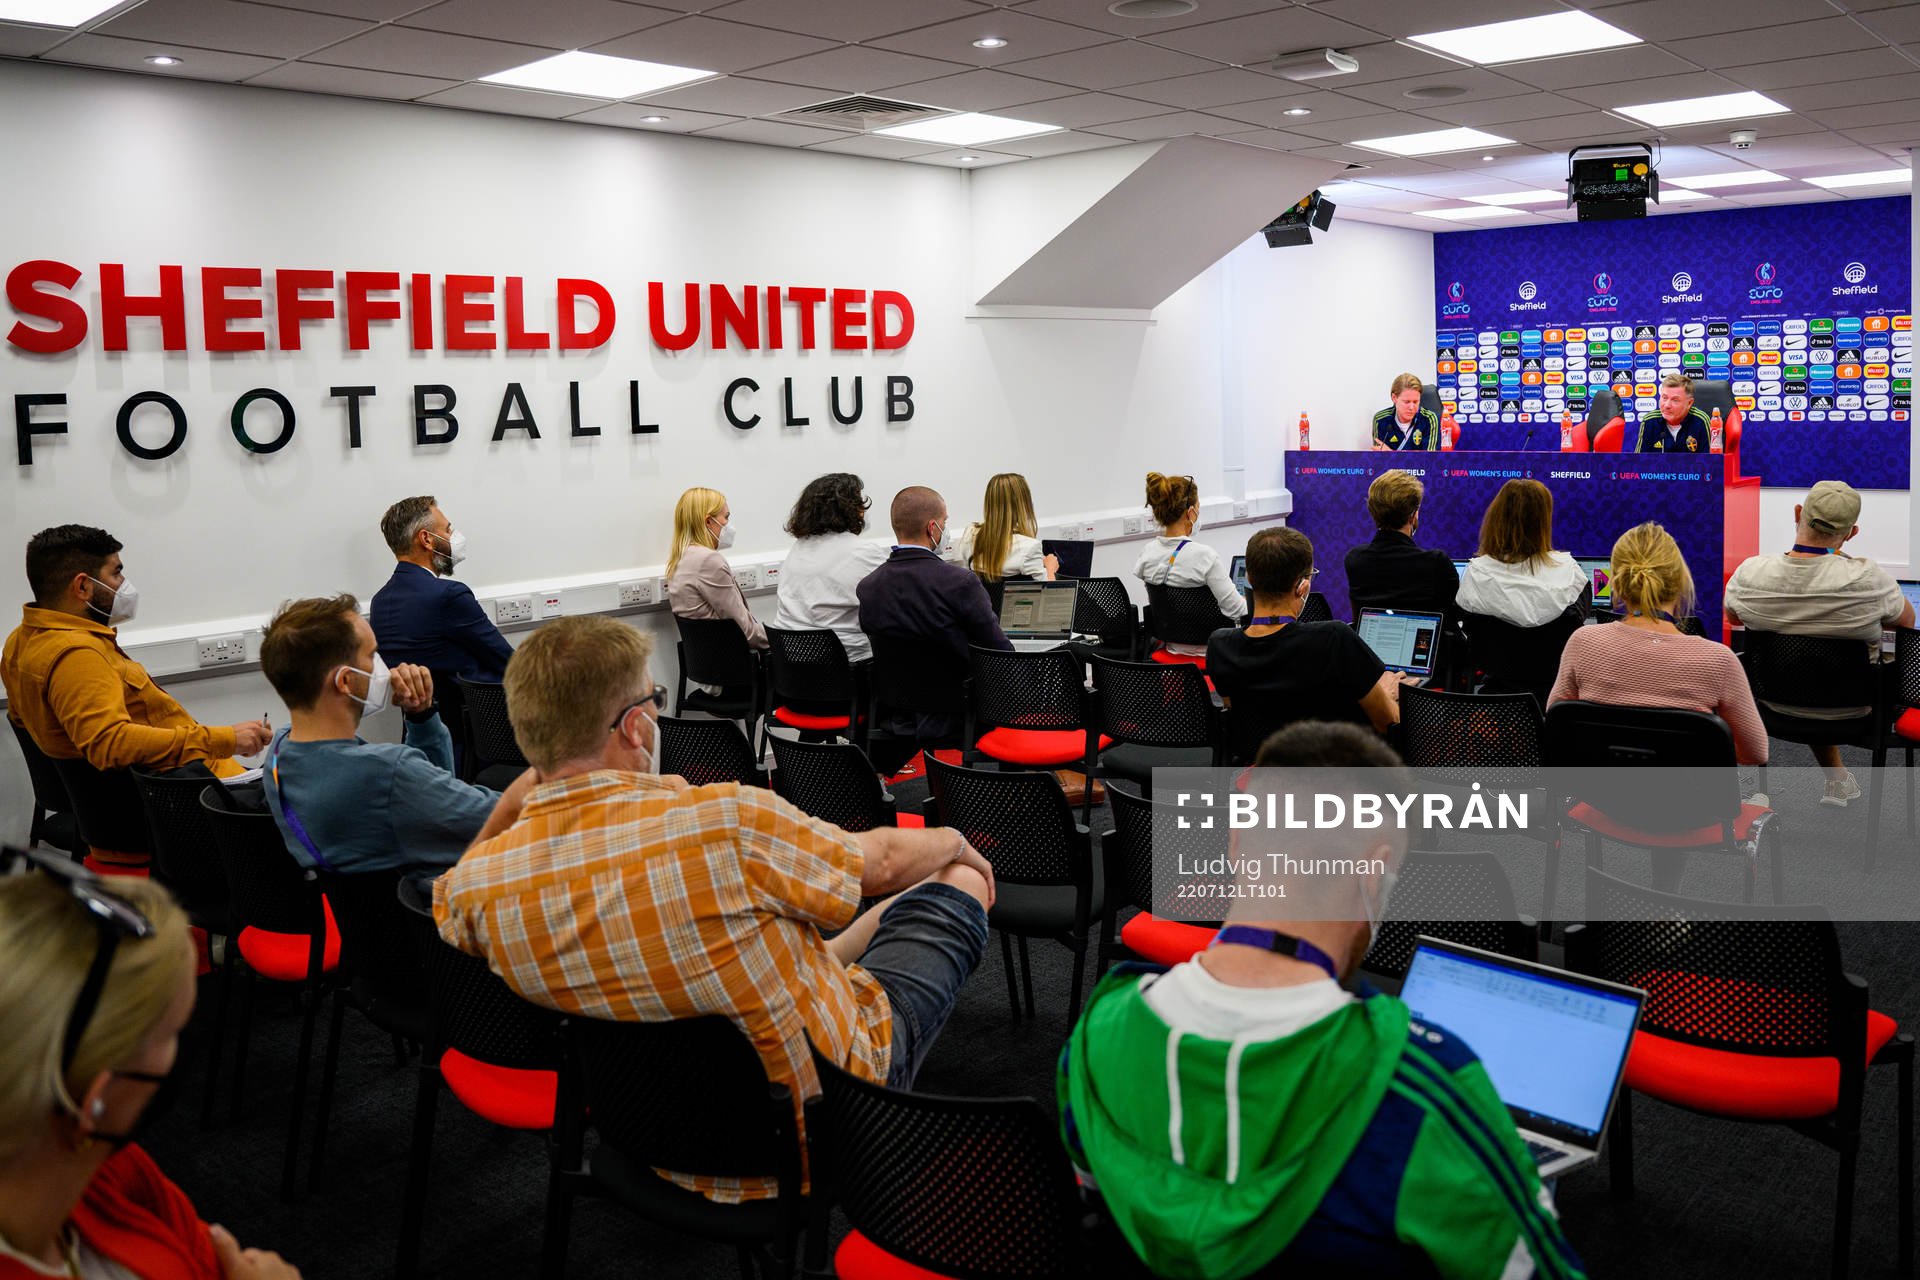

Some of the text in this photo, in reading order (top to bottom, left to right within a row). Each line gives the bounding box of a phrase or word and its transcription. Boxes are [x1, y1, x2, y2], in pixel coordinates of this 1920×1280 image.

[1832, 285, 1878, 296] Sheffield
[1661, 293, 1703, 304] Sheffield
[6, 260, 915, 353] SHEFFIELD UNITED
[1509, 301, 1547, 311] Sheffield
[14, 376, 914, 465] FOOTBALL CLUB
[1550, 471, 1591, 479] SHEFFIELD
